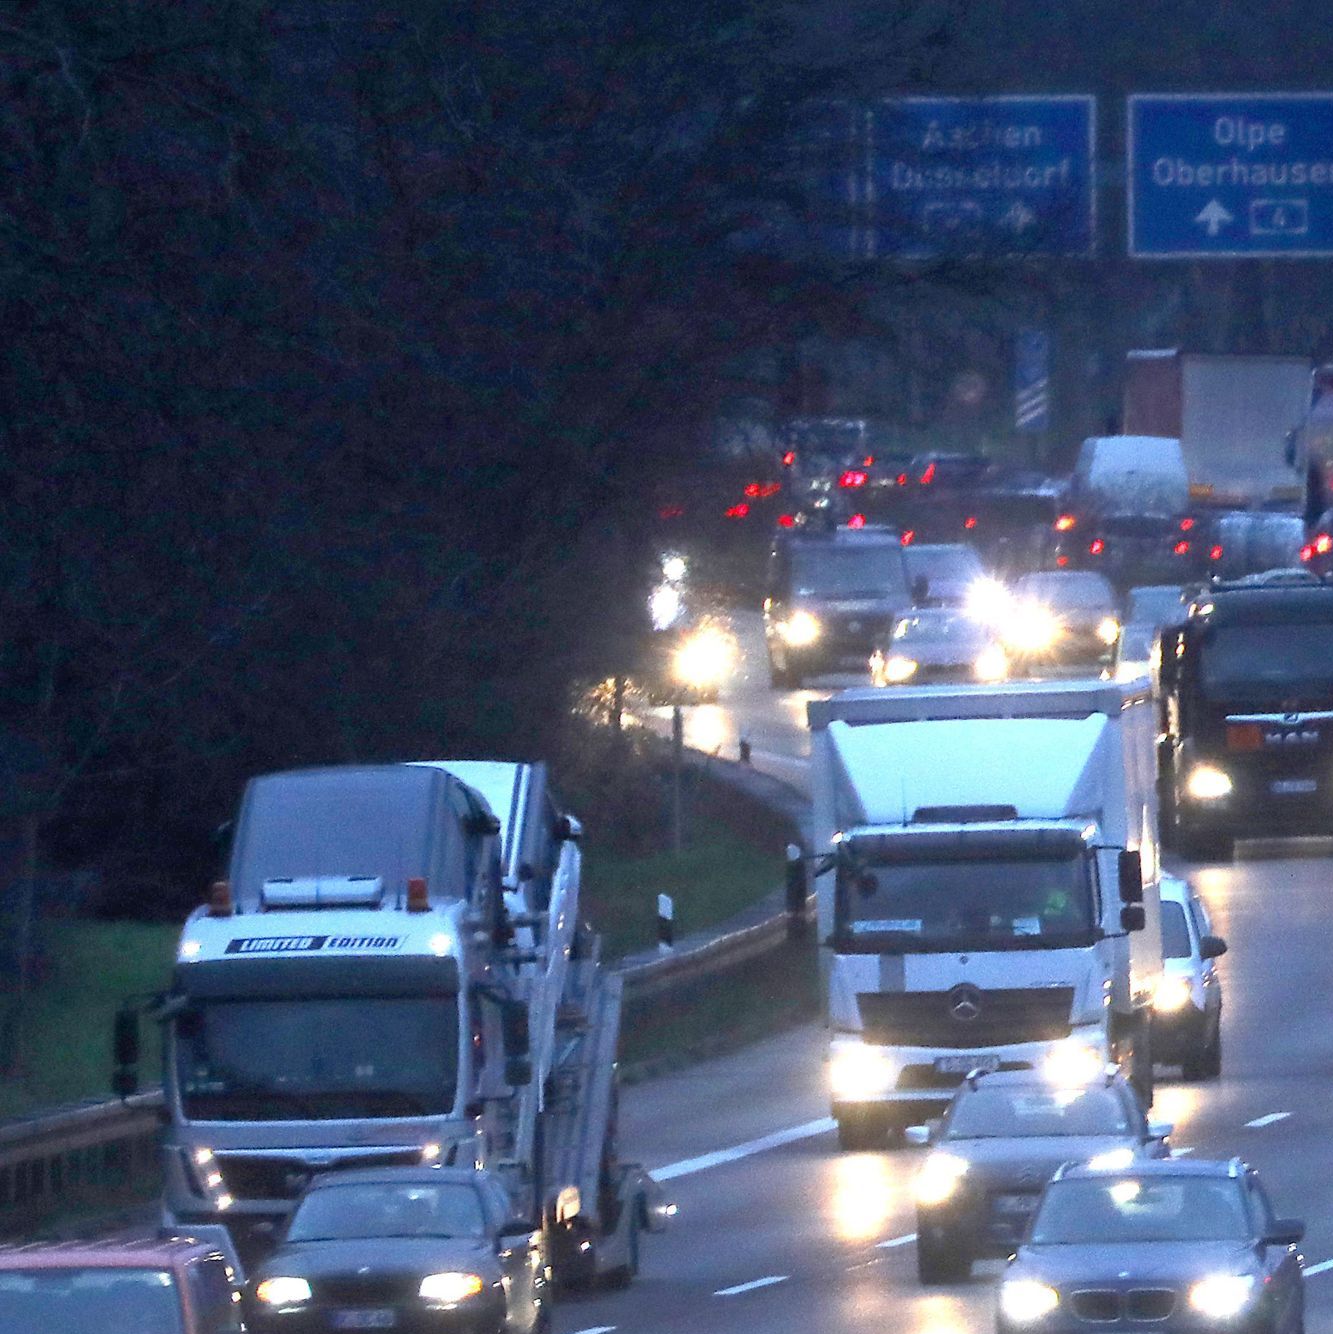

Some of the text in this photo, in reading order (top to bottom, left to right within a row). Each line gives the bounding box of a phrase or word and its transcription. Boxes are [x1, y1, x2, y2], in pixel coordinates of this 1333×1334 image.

[1214, 115, 1287, 152] Olpe
[240, 935, 400, 952] LIMITED EDITION
